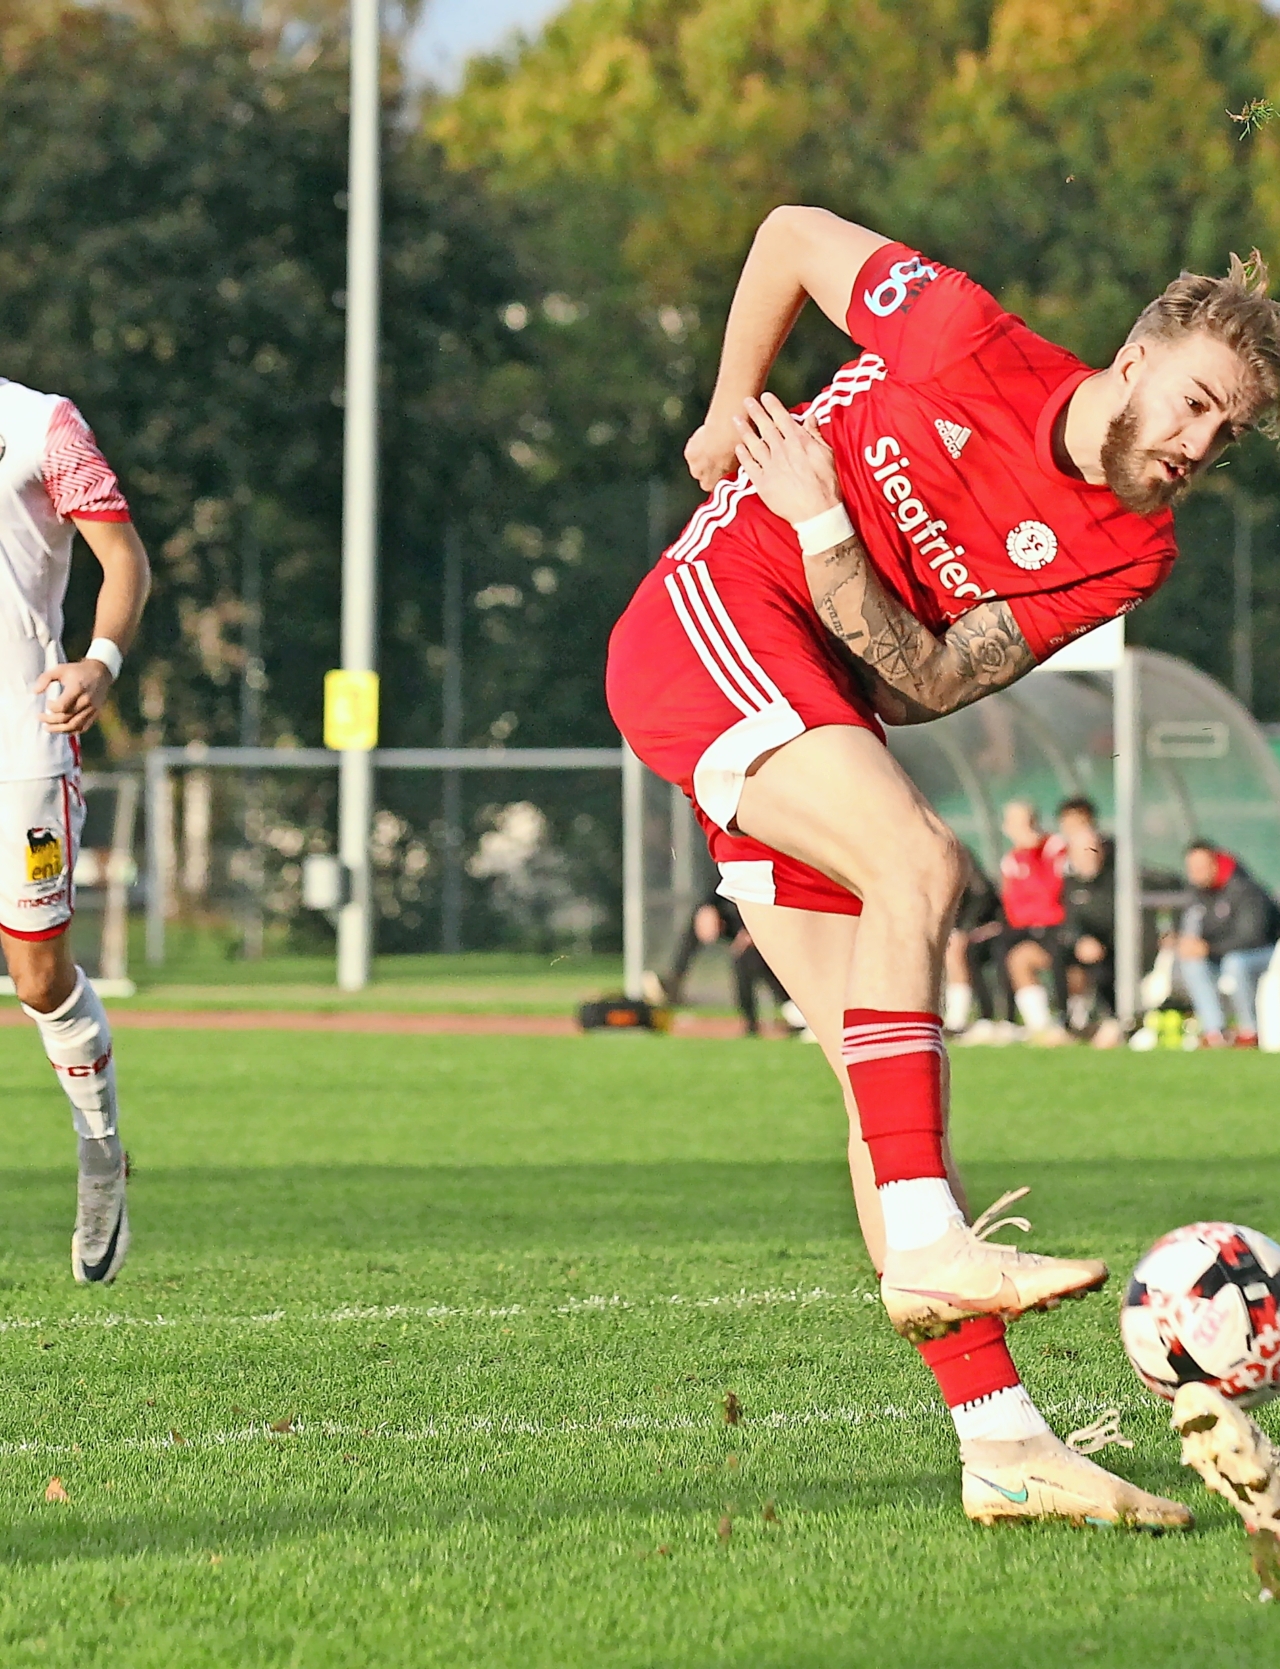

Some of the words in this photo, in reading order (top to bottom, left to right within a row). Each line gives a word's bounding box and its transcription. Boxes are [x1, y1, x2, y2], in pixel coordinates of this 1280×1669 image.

[934, 418, 962, 460] adidas
[864, 435, 998, 600] Siegfried
[31, 854, 61, 881] eni
